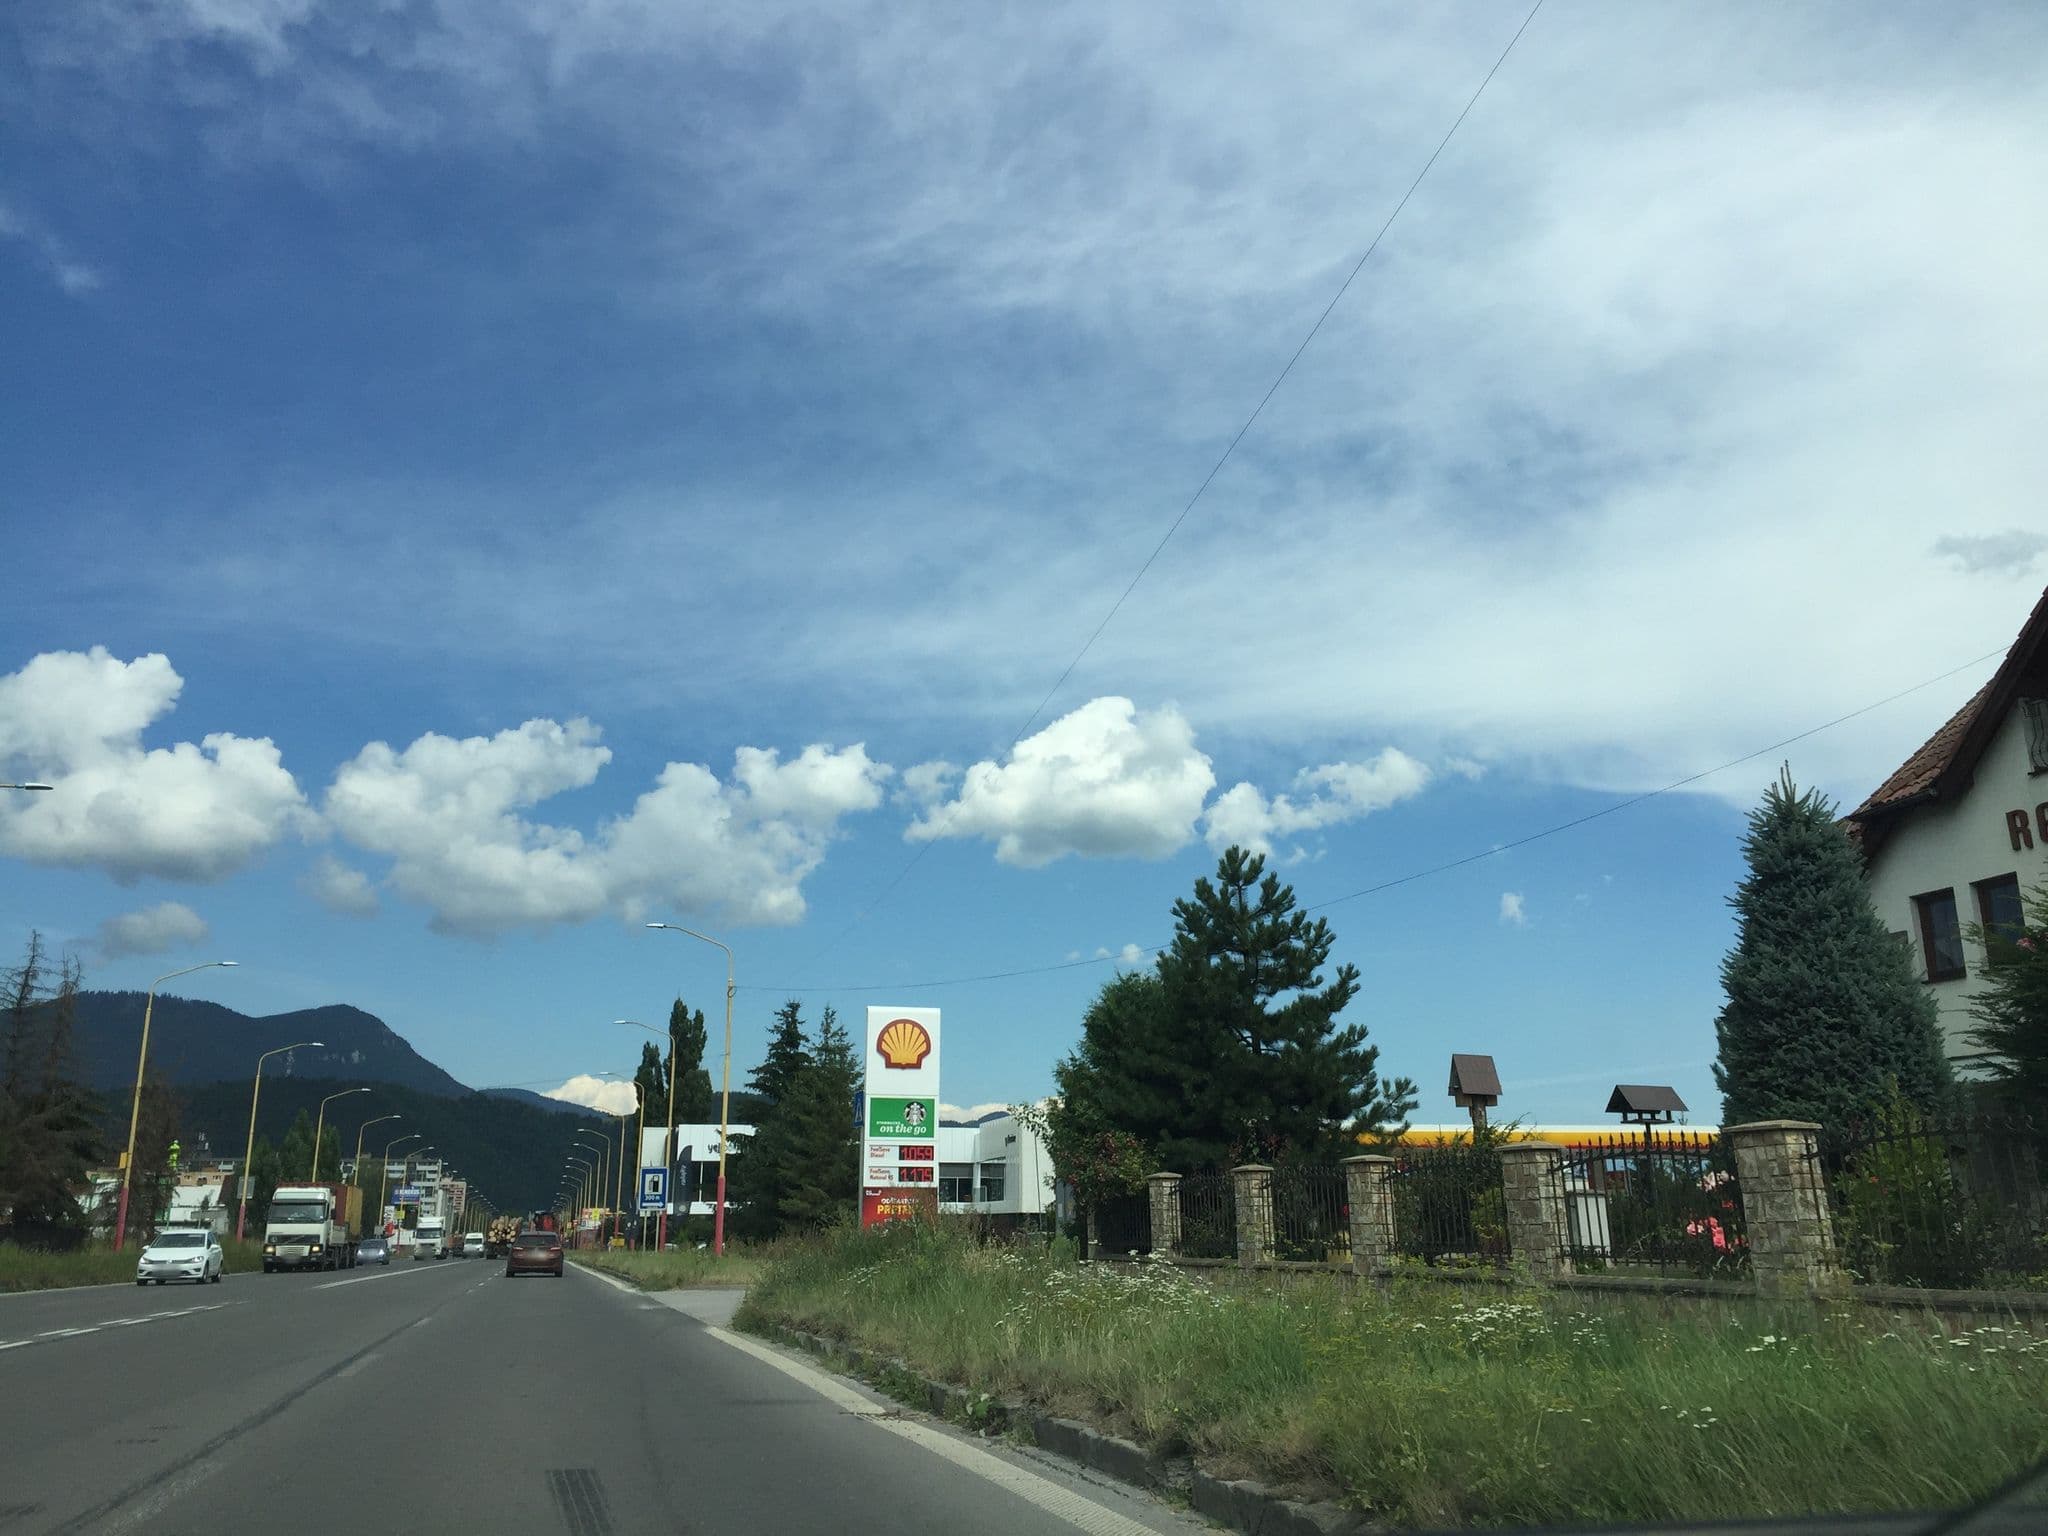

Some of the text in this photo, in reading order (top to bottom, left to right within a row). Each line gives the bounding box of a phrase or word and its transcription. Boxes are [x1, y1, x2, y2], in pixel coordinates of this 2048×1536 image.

[879, 1123, 927, 1136] on the go
